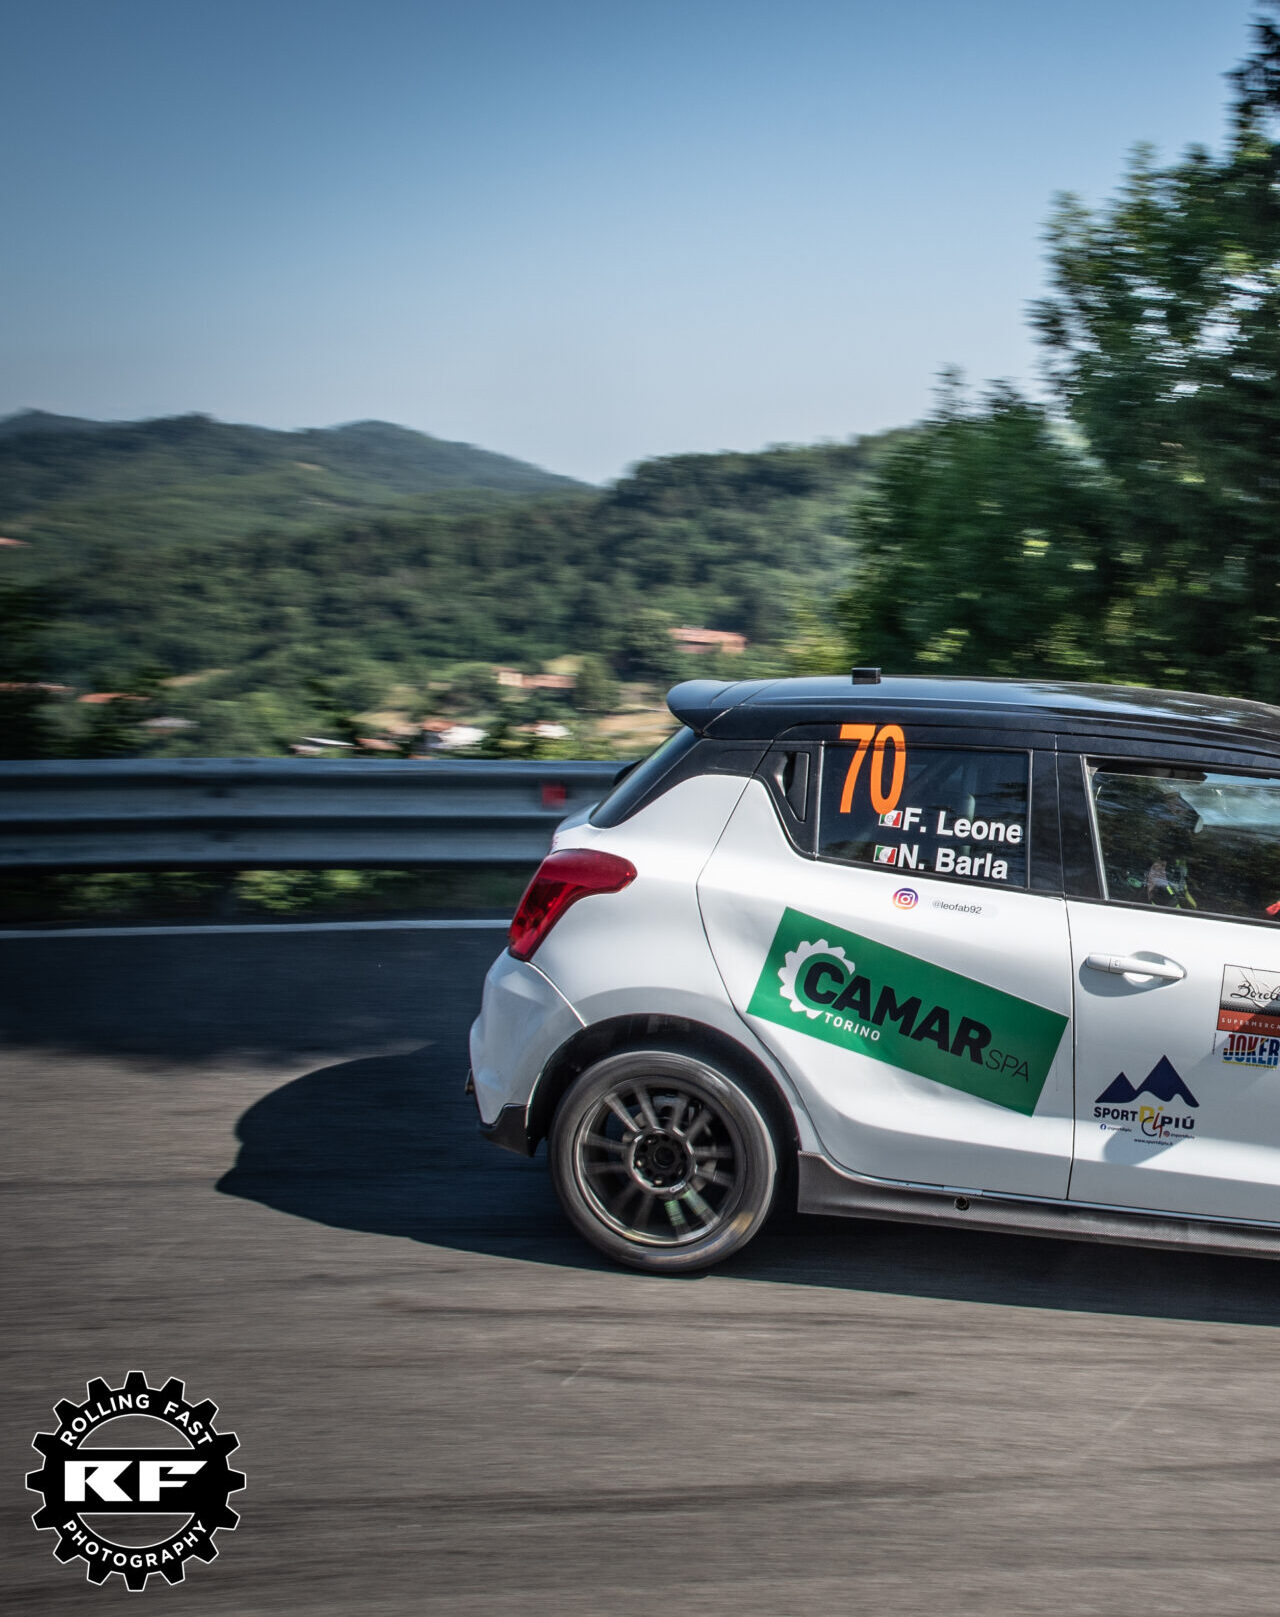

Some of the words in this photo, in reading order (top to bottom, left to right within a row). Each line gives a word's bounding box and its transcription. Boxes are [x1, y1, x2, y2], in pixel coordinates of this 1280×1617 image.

[839, 724, 907, 814] 70
[902, 807, 926, 833] F.
[937, 811, 1022, 844] Leone
[898, 844, 925, 870] N.
[935, 848, 1008, 880] Barla
[932, 901, 983, 915] @leofab92
[803, 961, 992, 1065] CAMAR
[985, 1049, 1029, 1083] SPA
[824, 1012, 881, 1041] TORINO
[1223, 1034, 1280, 1066] JOKER
[1093, 1106, 1138, 1122] SPORT
